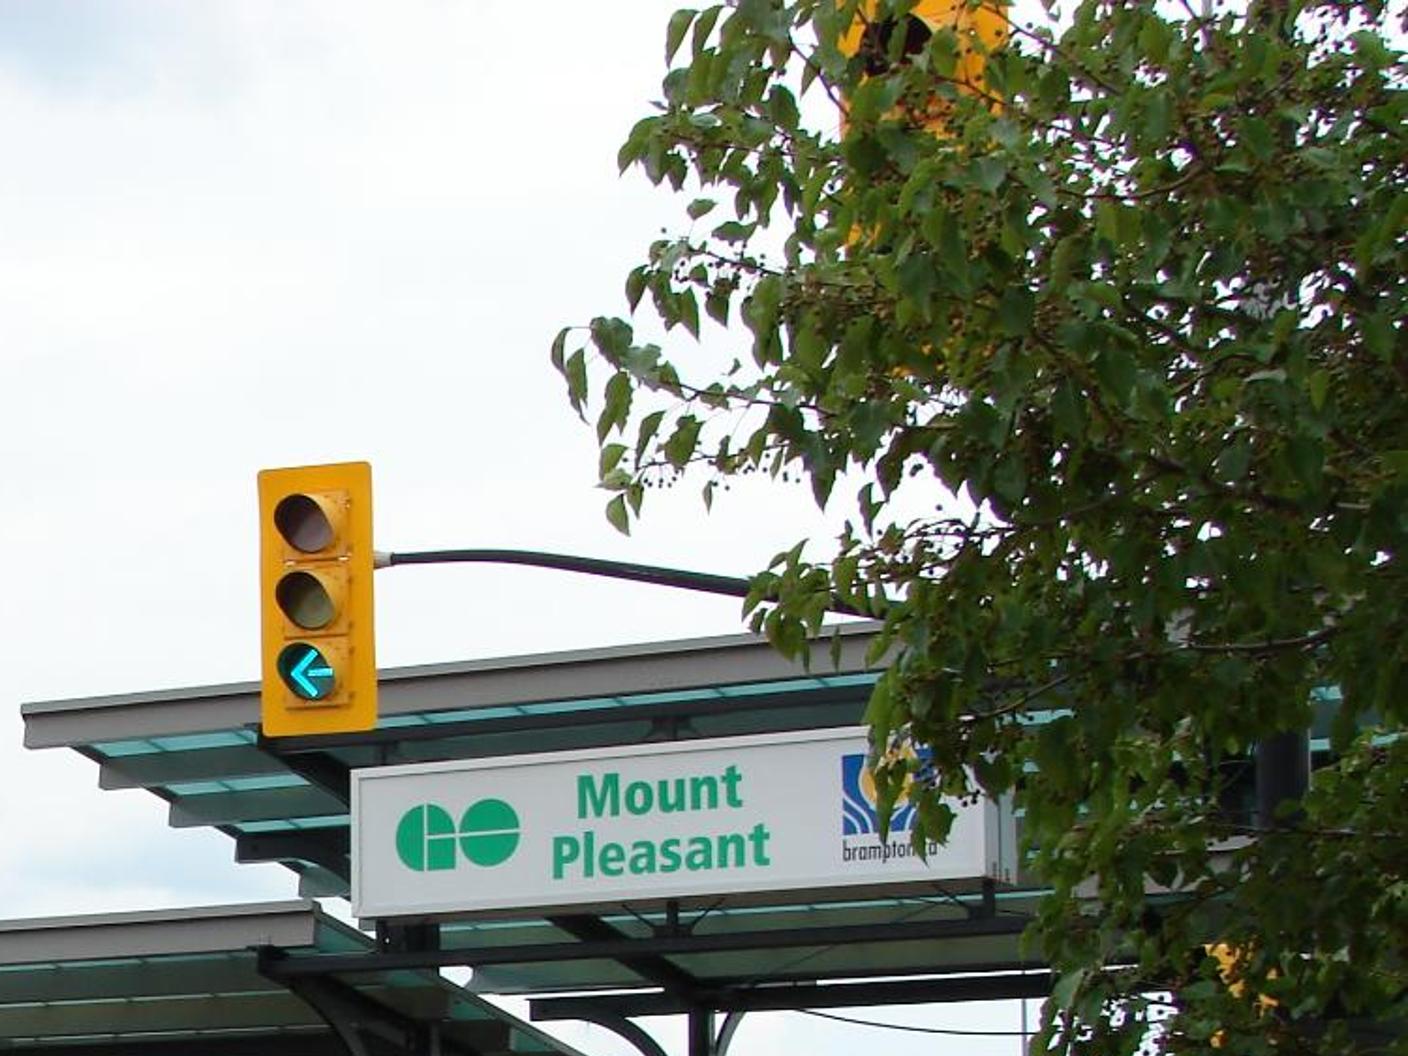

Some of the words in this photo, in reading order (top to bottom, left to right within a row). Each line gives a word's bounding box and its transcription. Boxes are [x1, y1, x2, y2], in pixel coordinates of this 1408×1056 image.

[577, 765, 743, 819] Mount
[395, 798, 520, 872] GO
[552, 823, 771, 880] Pleasant
[842, 839, 938, 863] bramptona
